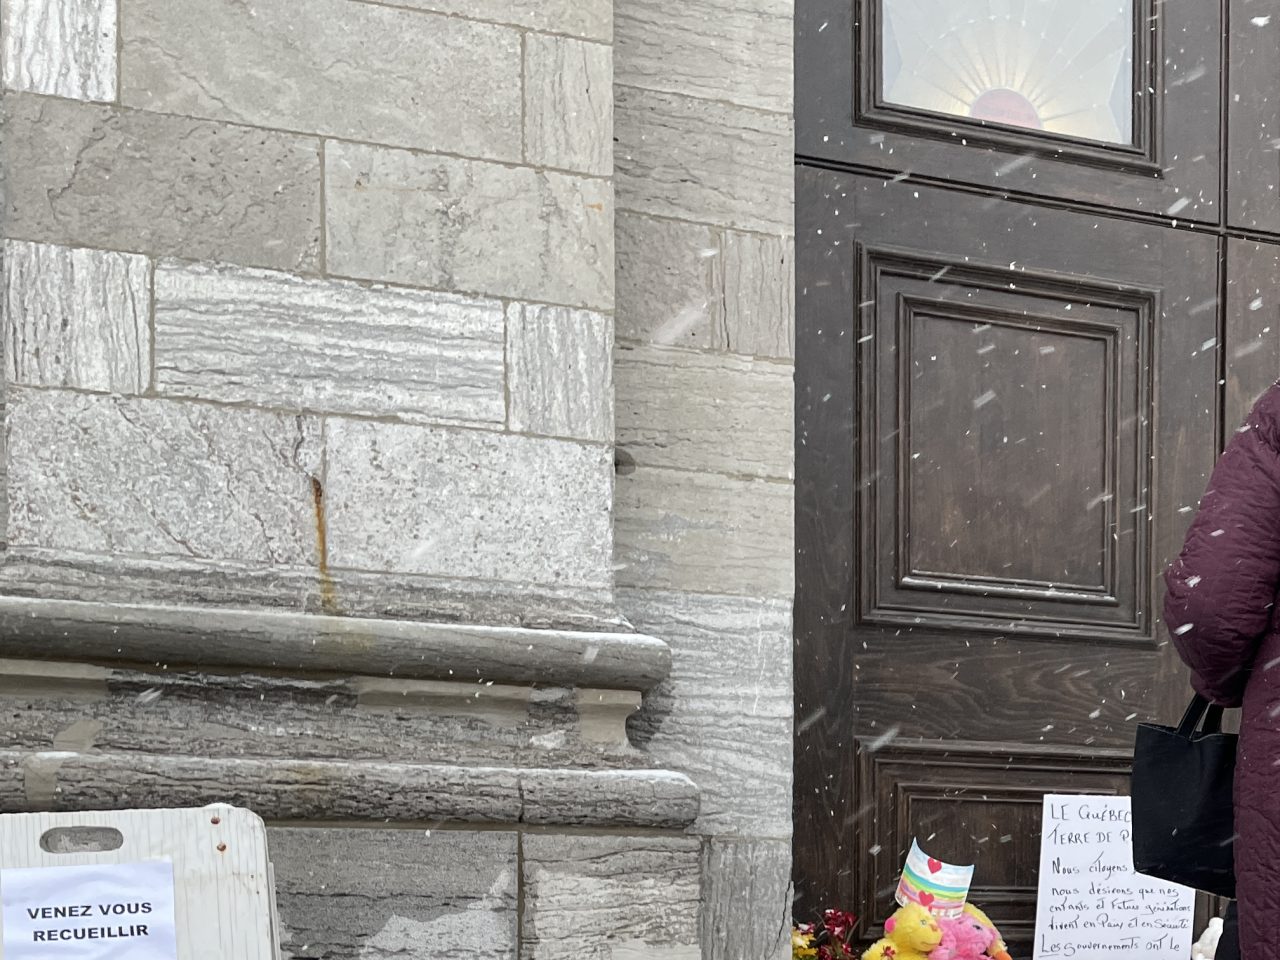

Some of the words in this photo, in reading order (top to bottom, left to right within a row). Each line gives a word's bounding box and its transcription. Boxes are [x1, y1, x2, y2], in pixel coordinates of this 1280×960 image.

[1050, 803, 1071, 821] LE
[1047, 823, 1091, 845] TERRE
[1095, 831, 1113, 843] DE
[1052, 856, 1080, 875] Nous
[1051, 886, 1080, 896] nous
[1138, 888, 1156, 900] que
[1159, 888, 1180, 898] nos
[27, 905, 93, 920] VENEZ
[98, 902, 153, 916] VOUS
[1096, 897, 1106, 910] et
[1083, 920, 1096, 928] en
[1128, 917, 1138, 928] et
[33, 924, 149, 942] RECUEILLIR
